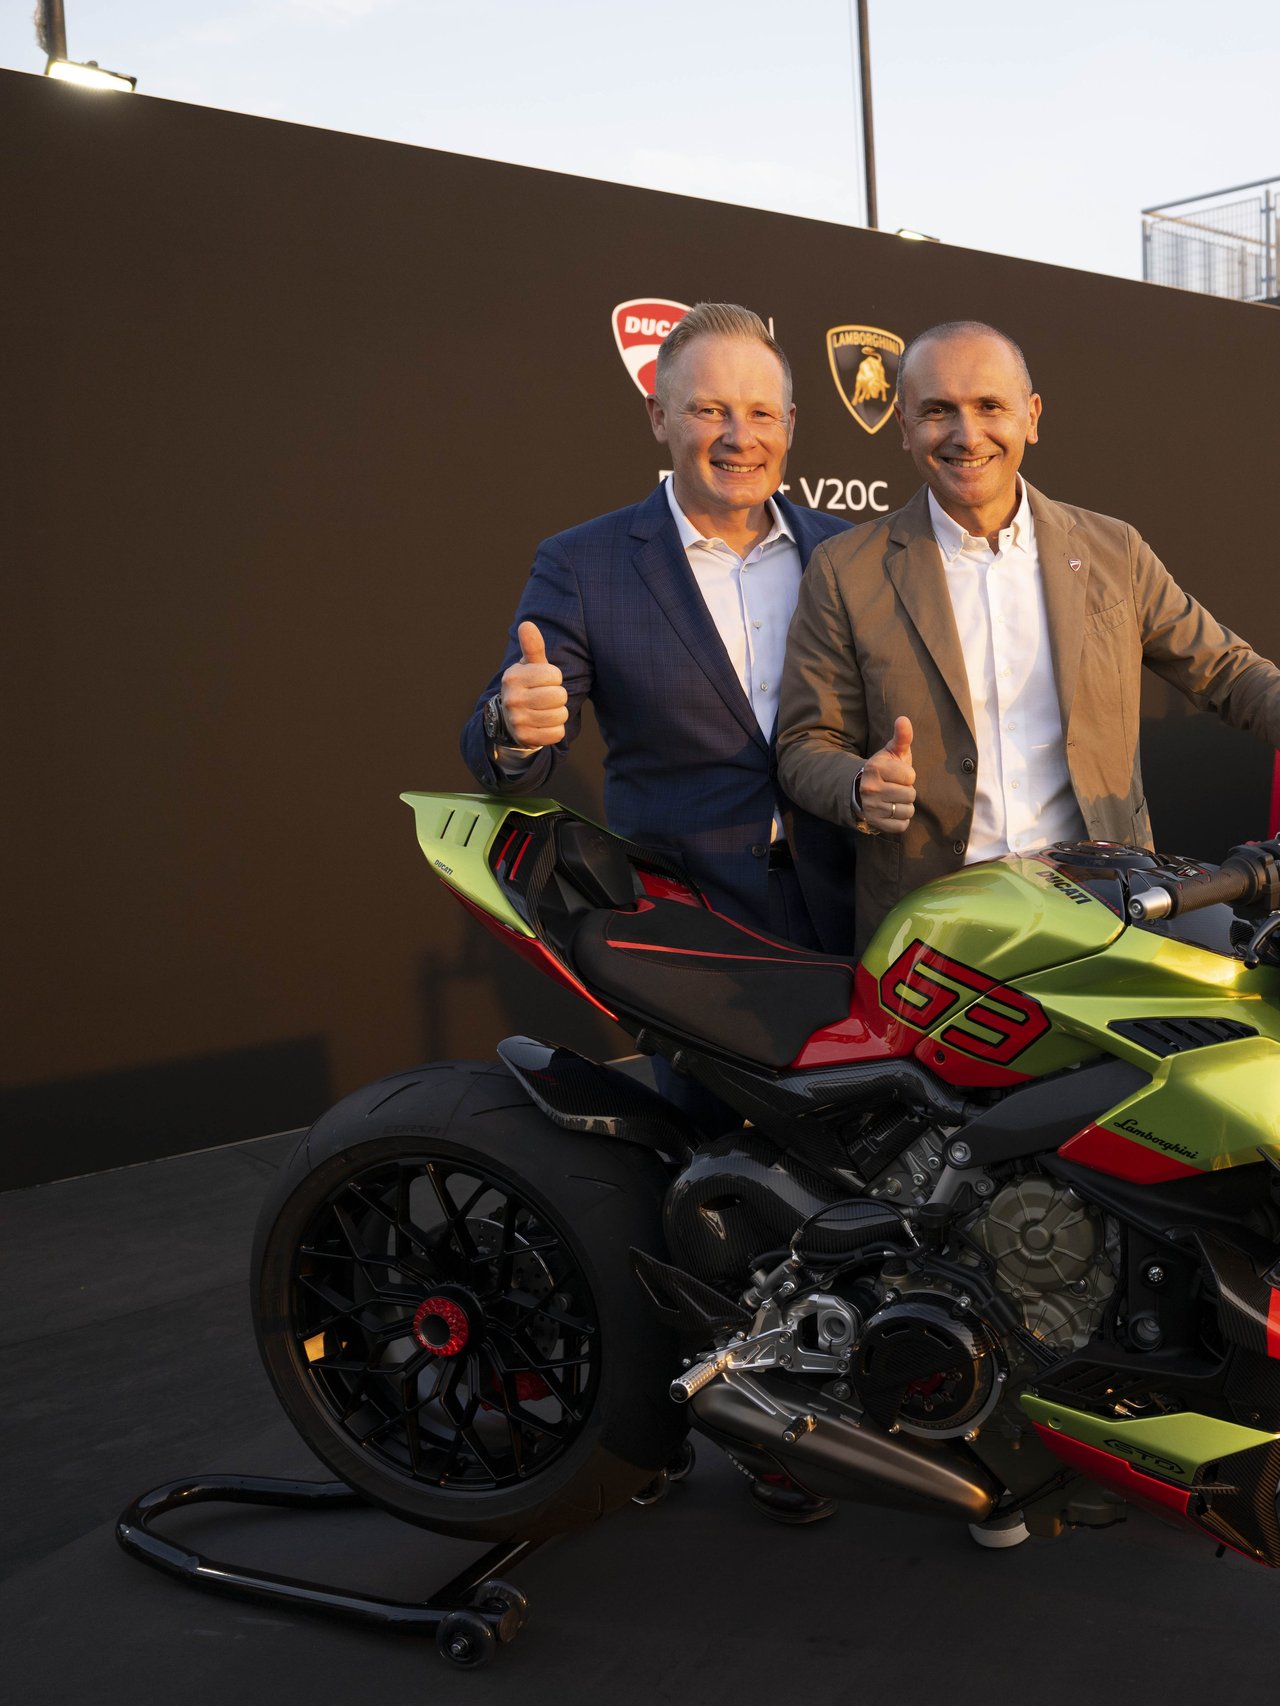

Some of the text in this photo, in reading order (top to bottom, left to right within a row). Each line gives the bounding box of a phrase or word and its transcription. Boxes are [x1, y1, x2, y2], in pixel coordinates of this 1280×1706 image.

[833, 331, 900, 356] LAMBORGHINI
[434, 859, 454, 876] DUCATI
[1036, 870, 1094, 905] DUCATI
[879, 937, 1053, 1067] 63
[1113, 1118, 1200, 1160] Lamborghini
[1114, 1441, 1176, 1472] STO
